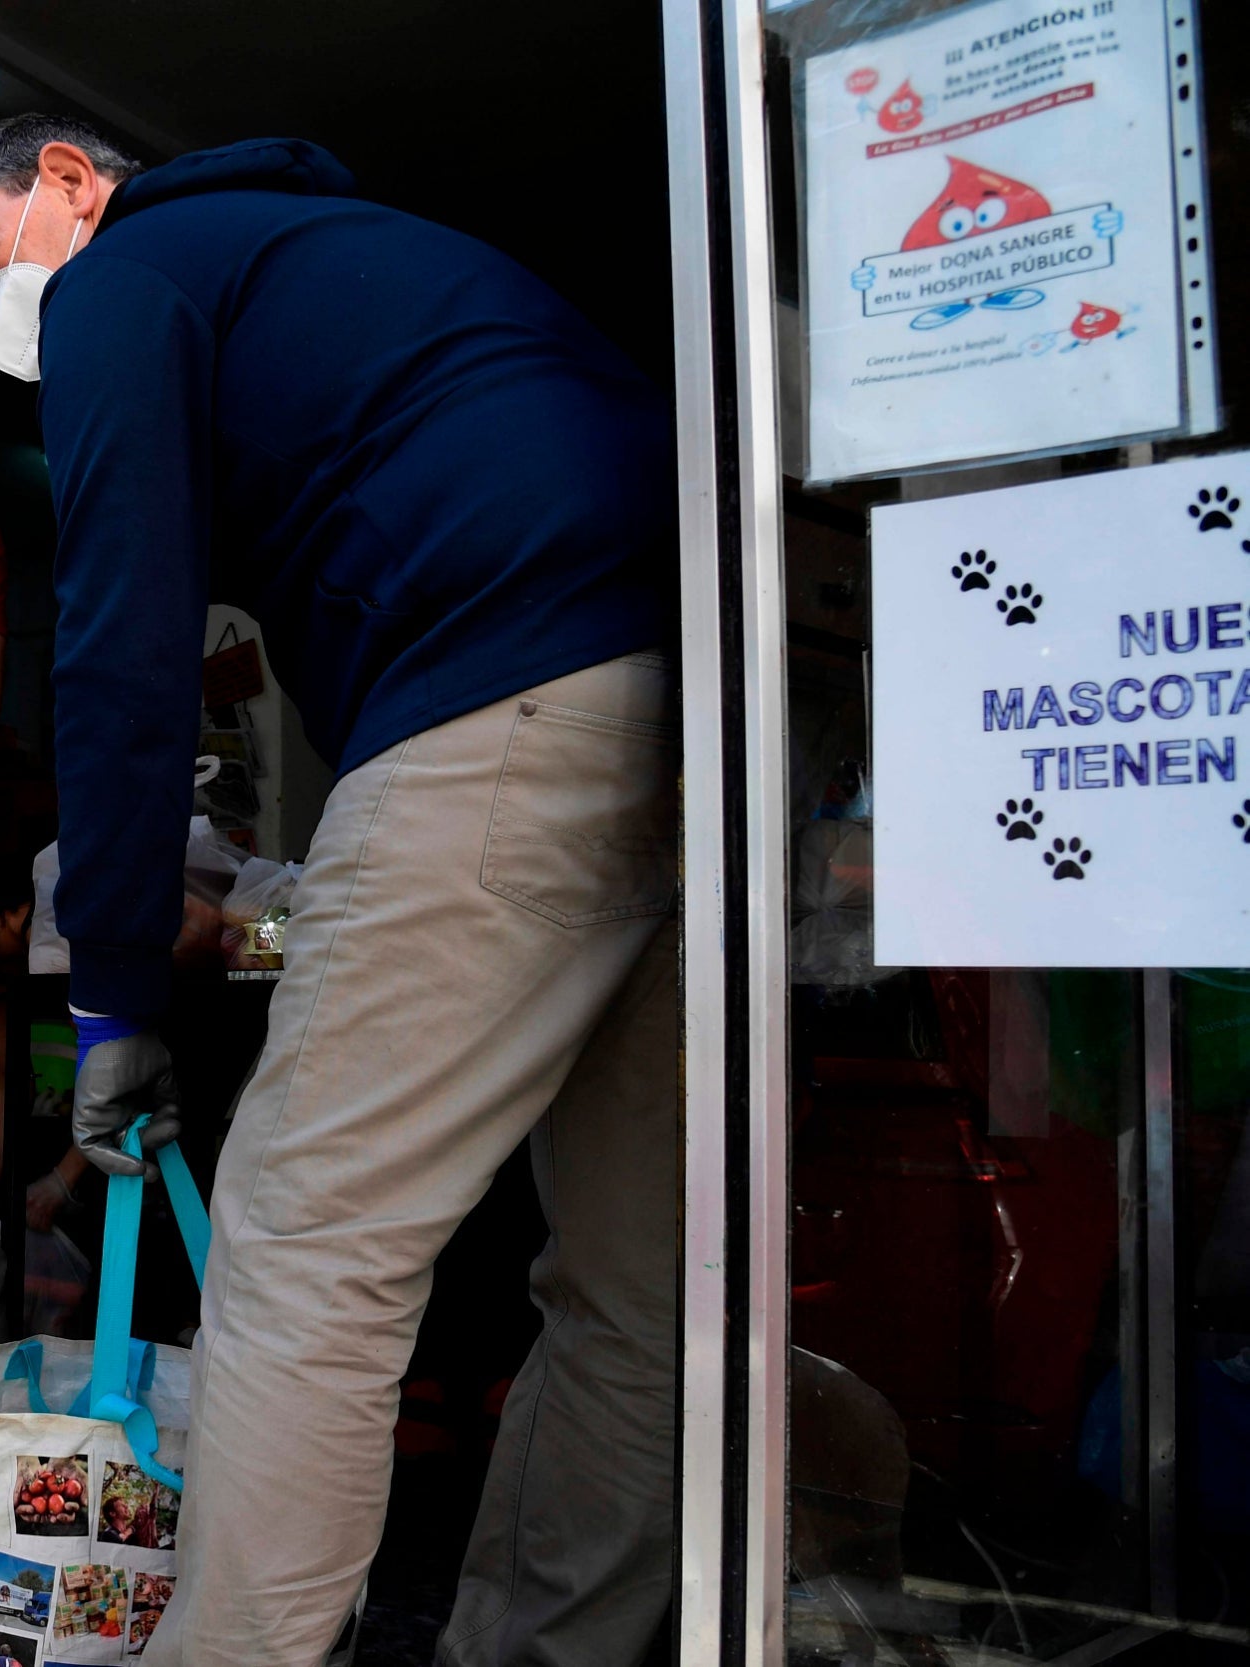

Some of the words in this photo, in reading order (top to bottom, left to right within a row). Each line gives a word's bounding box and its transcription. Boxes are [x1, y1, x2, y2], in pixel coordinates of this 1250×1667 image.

[970, 8, 1085, 54] ATENCIÓN
[943, 82, 989, 100] sangre
[994, 71, 1019, 87] que
[1023, 55, 1066, 75] donas
[966, 64, 1000, 80] hace
[1006, 42, 1061, 67] negocio
[1067, 35, 1095, 46] con
[991, 69, 1064, 99] autobuses
[874, 293, 892, 305] en
[896, 289, 911, 302] tu
[919, 268, 1004, 297] HOSPITAL
[1010, 244, 1094, 277] PÚBLICO
[888, 262, 934, 279] Mejor
[940, 246, 994, 271] DONA
[999, 224, 1077, 255] SANGRE
[1021, 735, 1236, 792] TIENEN
